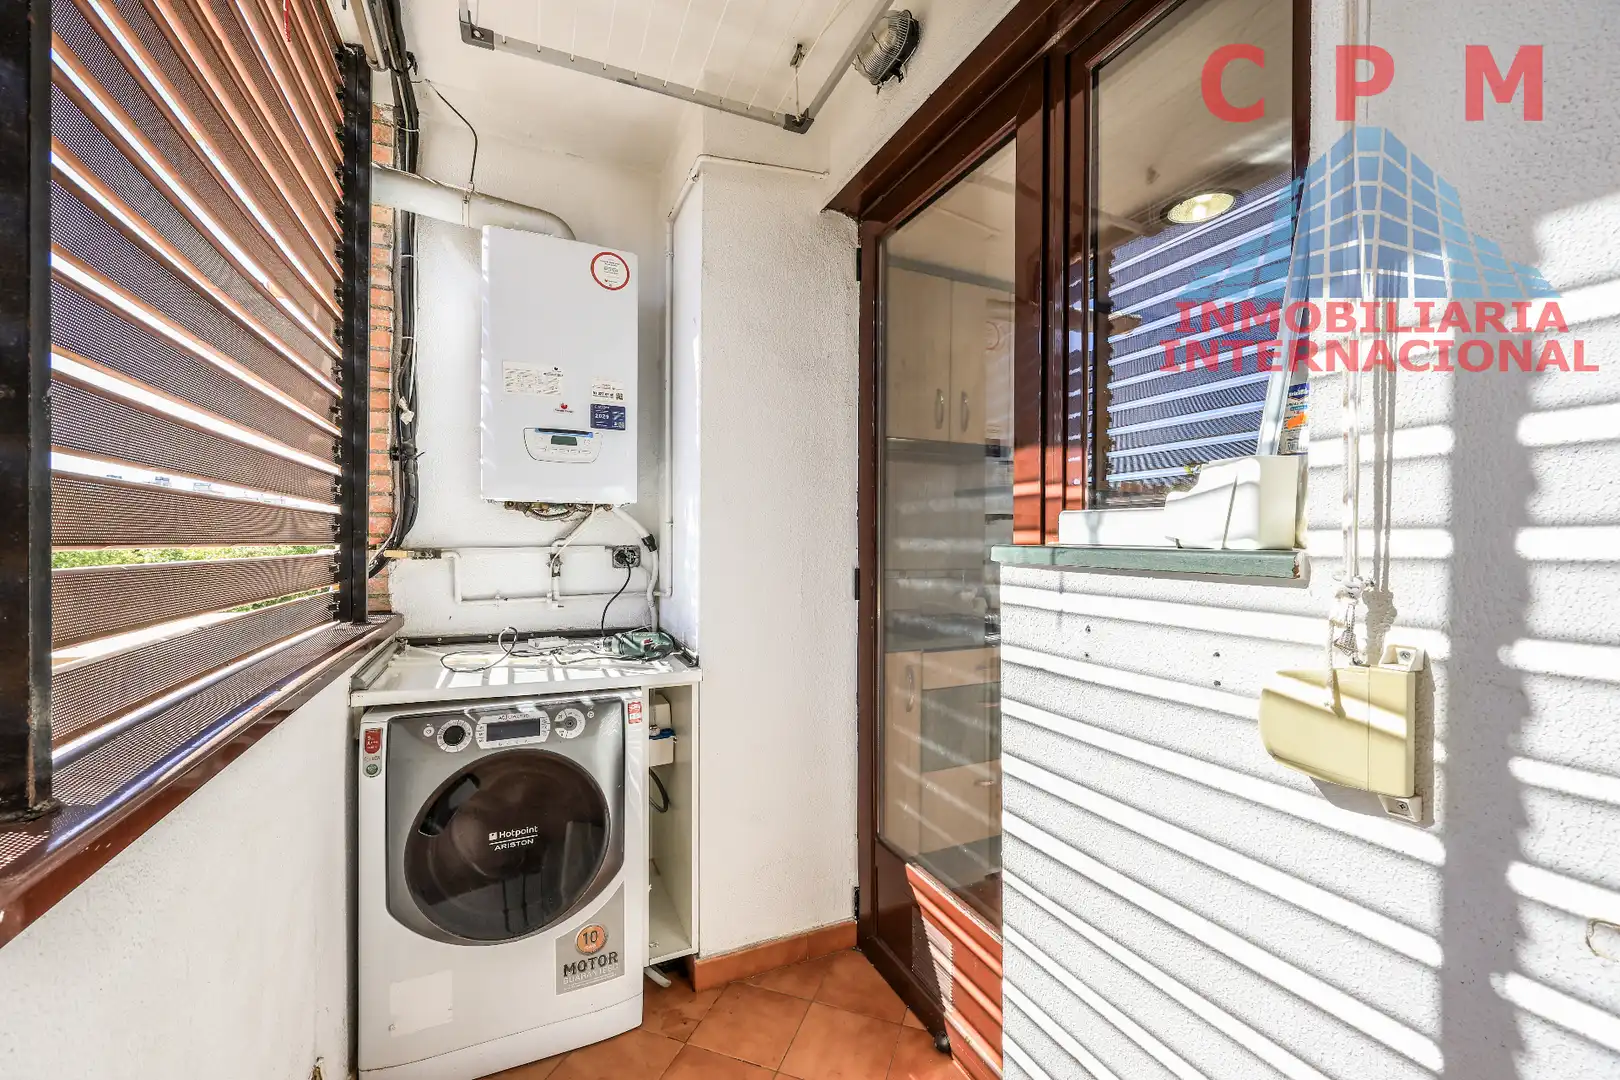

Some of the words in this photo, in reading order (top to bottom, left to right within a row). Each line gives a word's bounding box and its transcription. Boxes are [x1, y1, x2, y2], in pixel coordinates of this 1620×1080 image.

[498, 825, 538, 840] Hotpoint
[493, 838, 534, 852] ARISTON
[583, 930, 598, 945] 10
[562, 951, 619, 977] MOTOR
